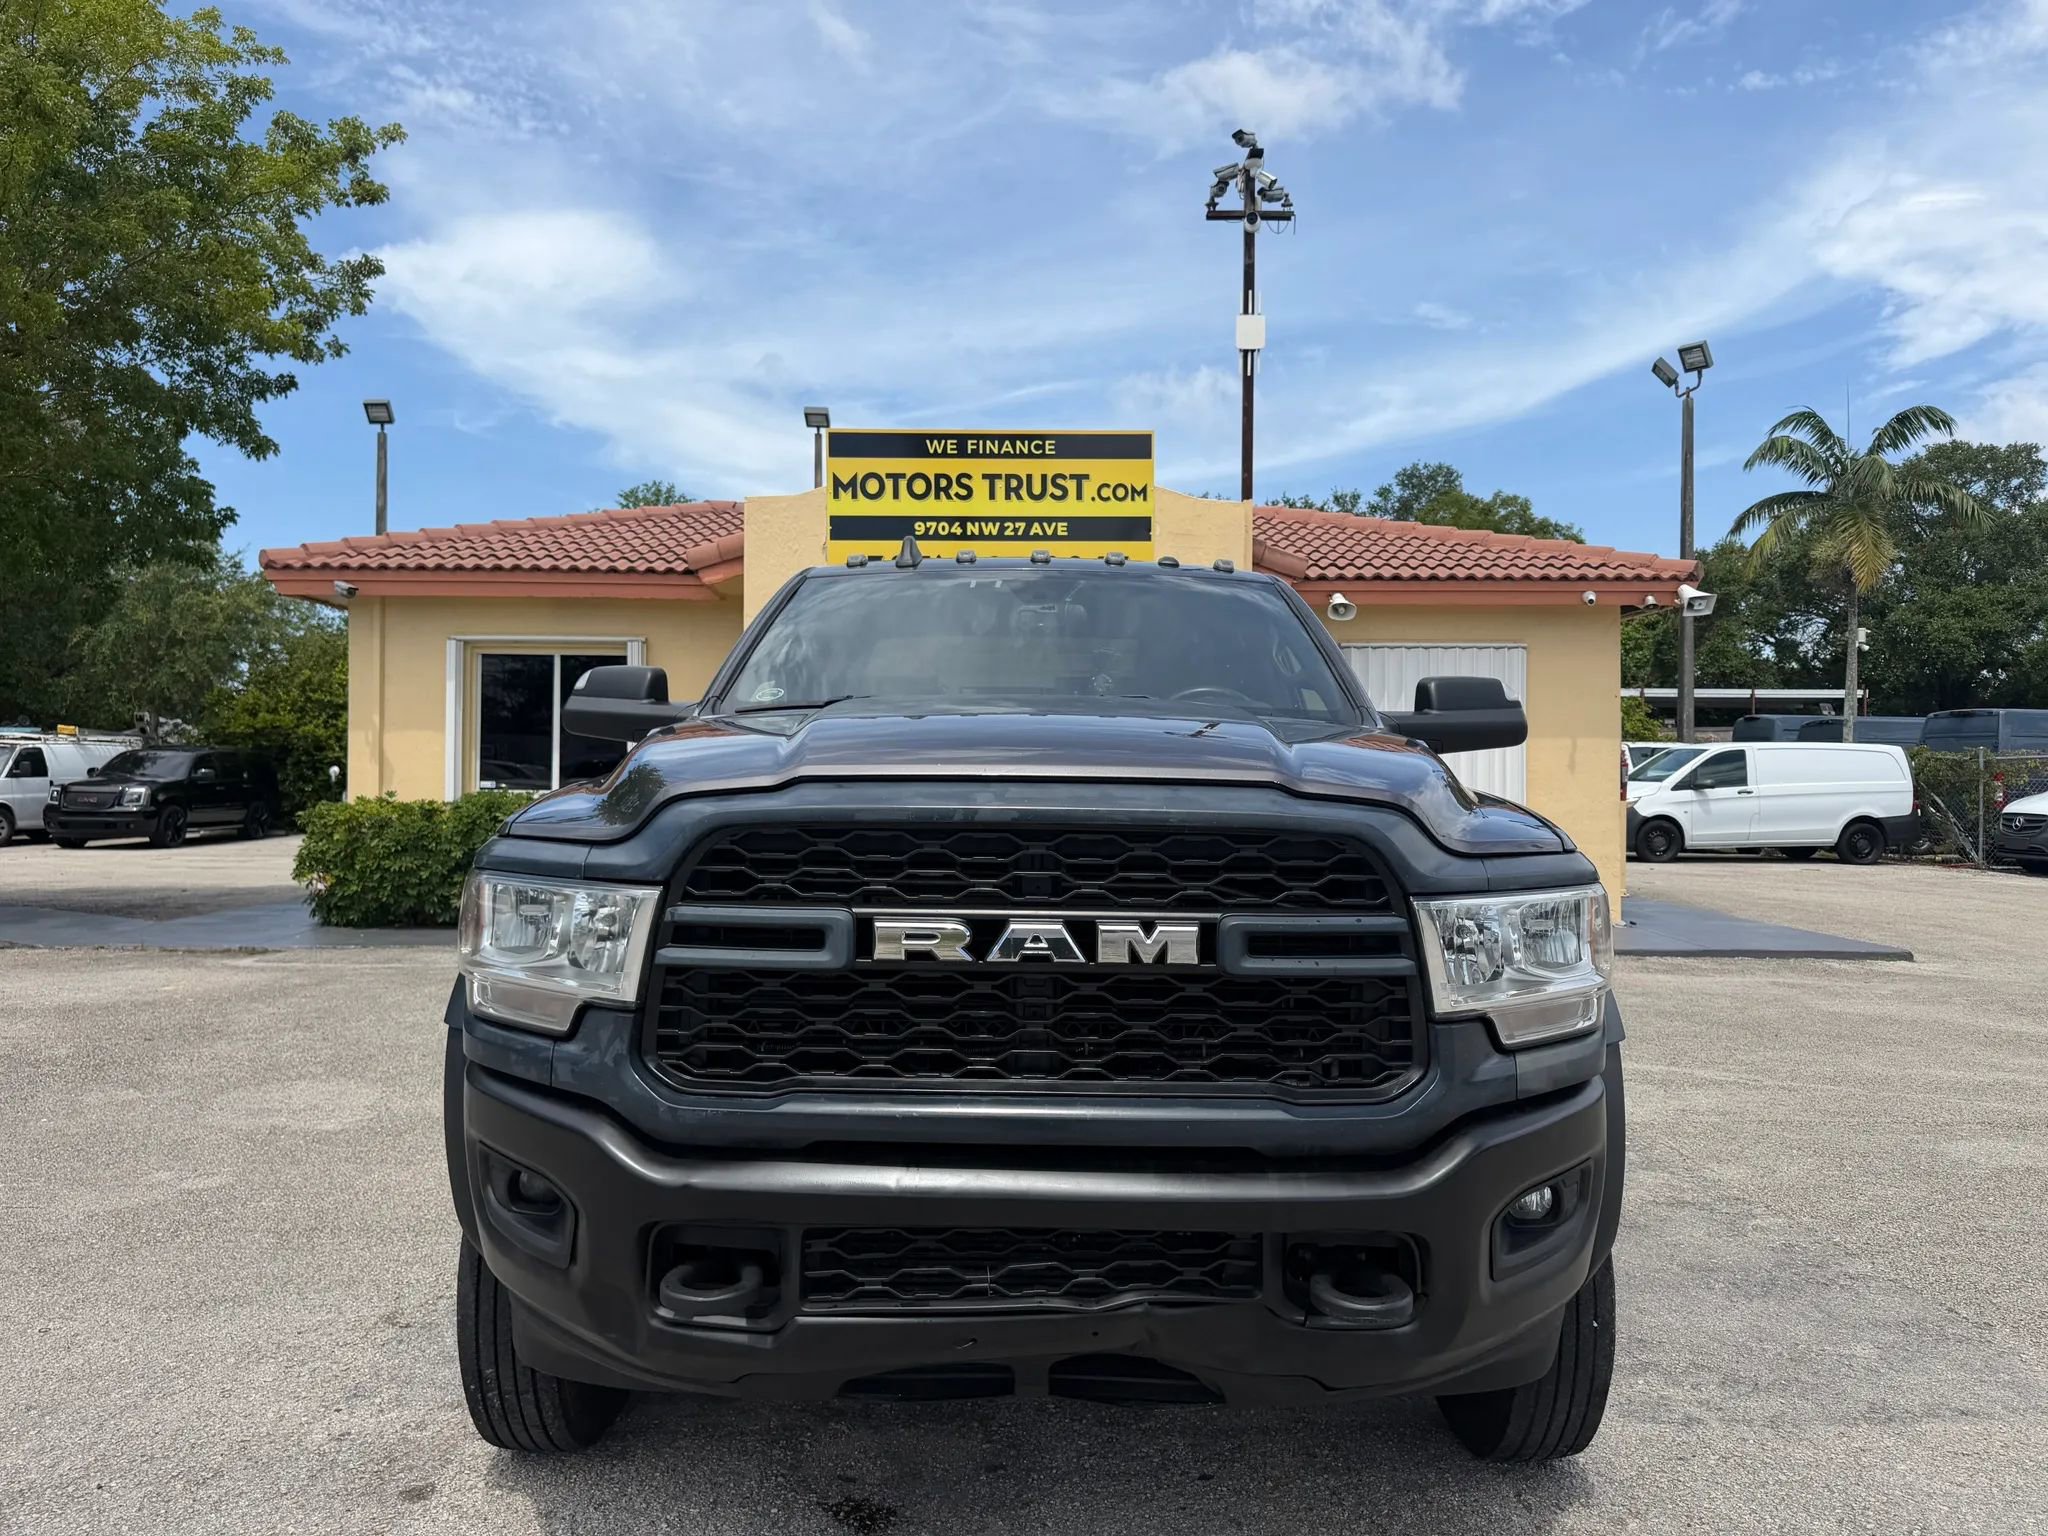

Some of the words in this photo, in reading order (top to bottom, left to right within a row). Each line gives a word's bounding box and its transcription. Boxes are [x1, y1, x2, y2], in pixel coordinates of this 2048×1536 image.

[926, 439, 958, 454] WE
[966, 440, 1056, 455] FINANCE
[832, 472, 974, 502] MOTORS
[914, 521, 963, 536] 9704
[967, 521, 999, 536] NW
[1004, 521, 1026, 536] 27
[1030, 521, 1068, 536] AVE
[873, 918, 1200, 965] RAM
